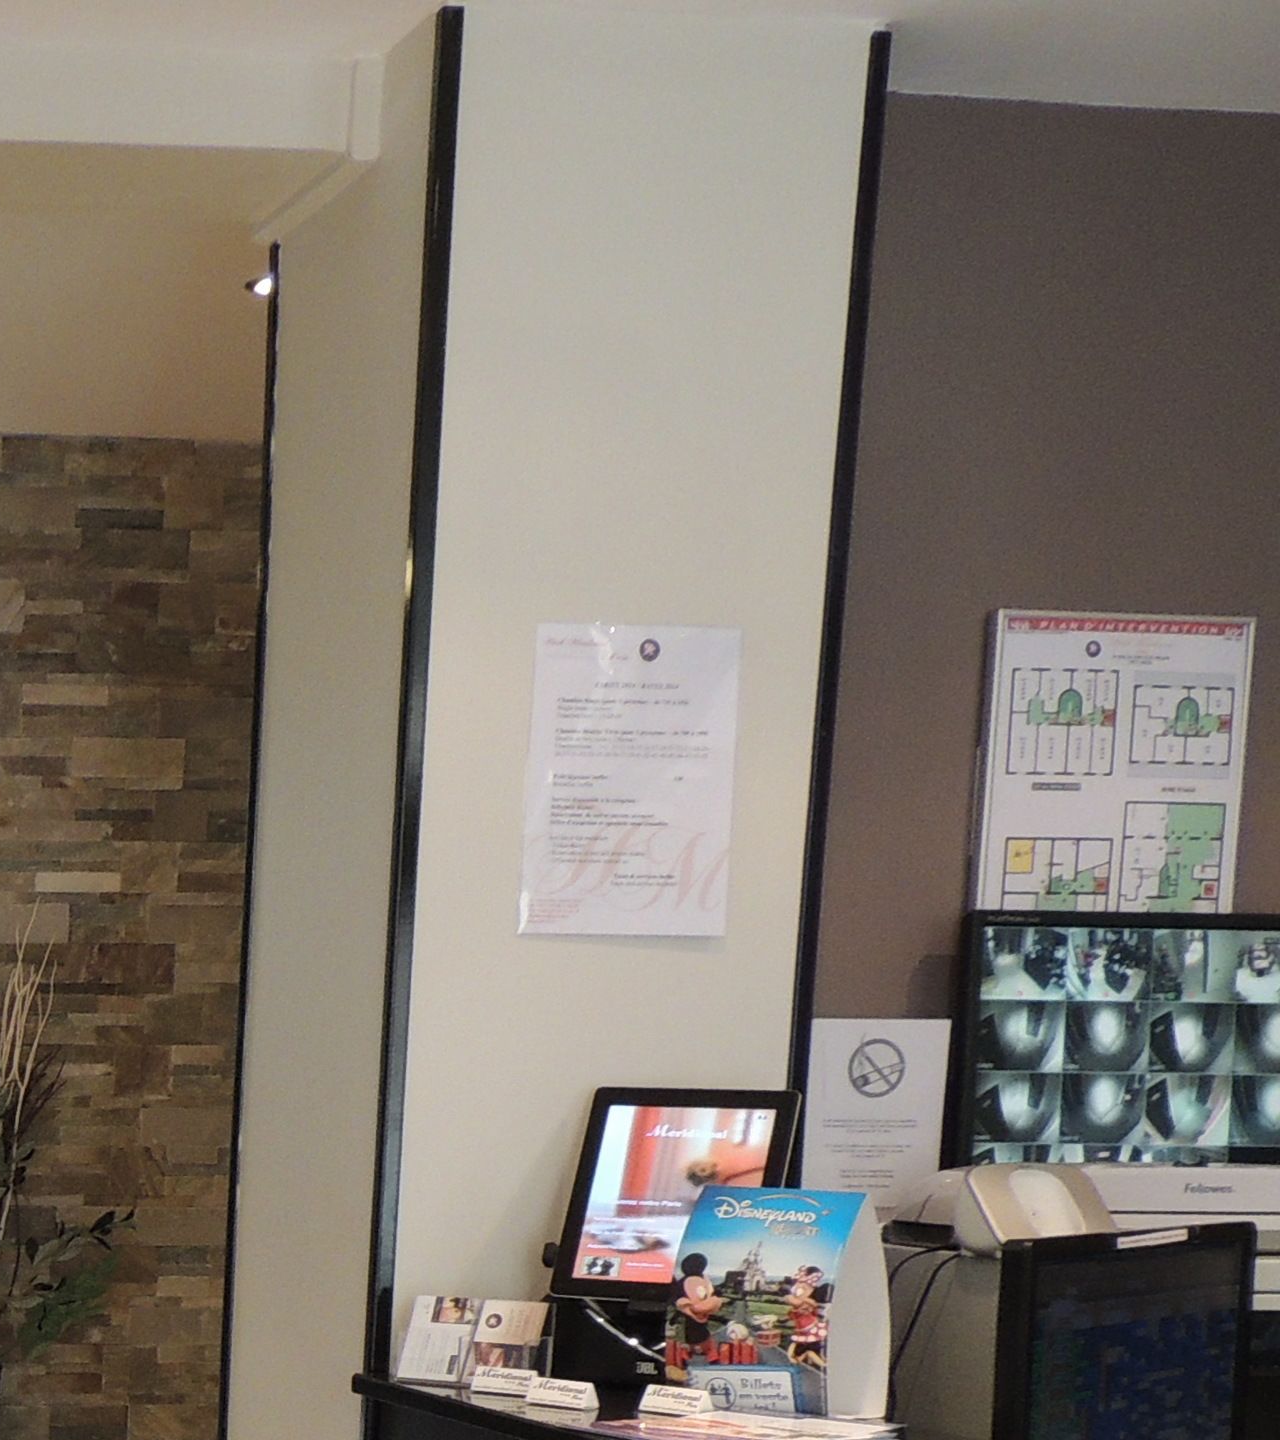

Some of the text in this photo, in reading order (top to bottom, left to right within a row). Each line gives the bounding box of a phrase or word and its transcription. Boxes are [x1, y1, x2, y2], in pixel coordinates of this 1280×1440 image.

[1039, 620, 1079, 632] PLAN
[1083, 621, 1220, 634] D'INTERVENTION
[645, 1124, 728, 1139] Meridnal
[1183, 1183, 1234, 1194] Fellowes
[636, 1361, 658, 1375] JBL
[533, 1380, 588, 1395] Meridional
[740, 1378, 782, 1390] Billets
[647, 1387, 703, 1402] Meridional
